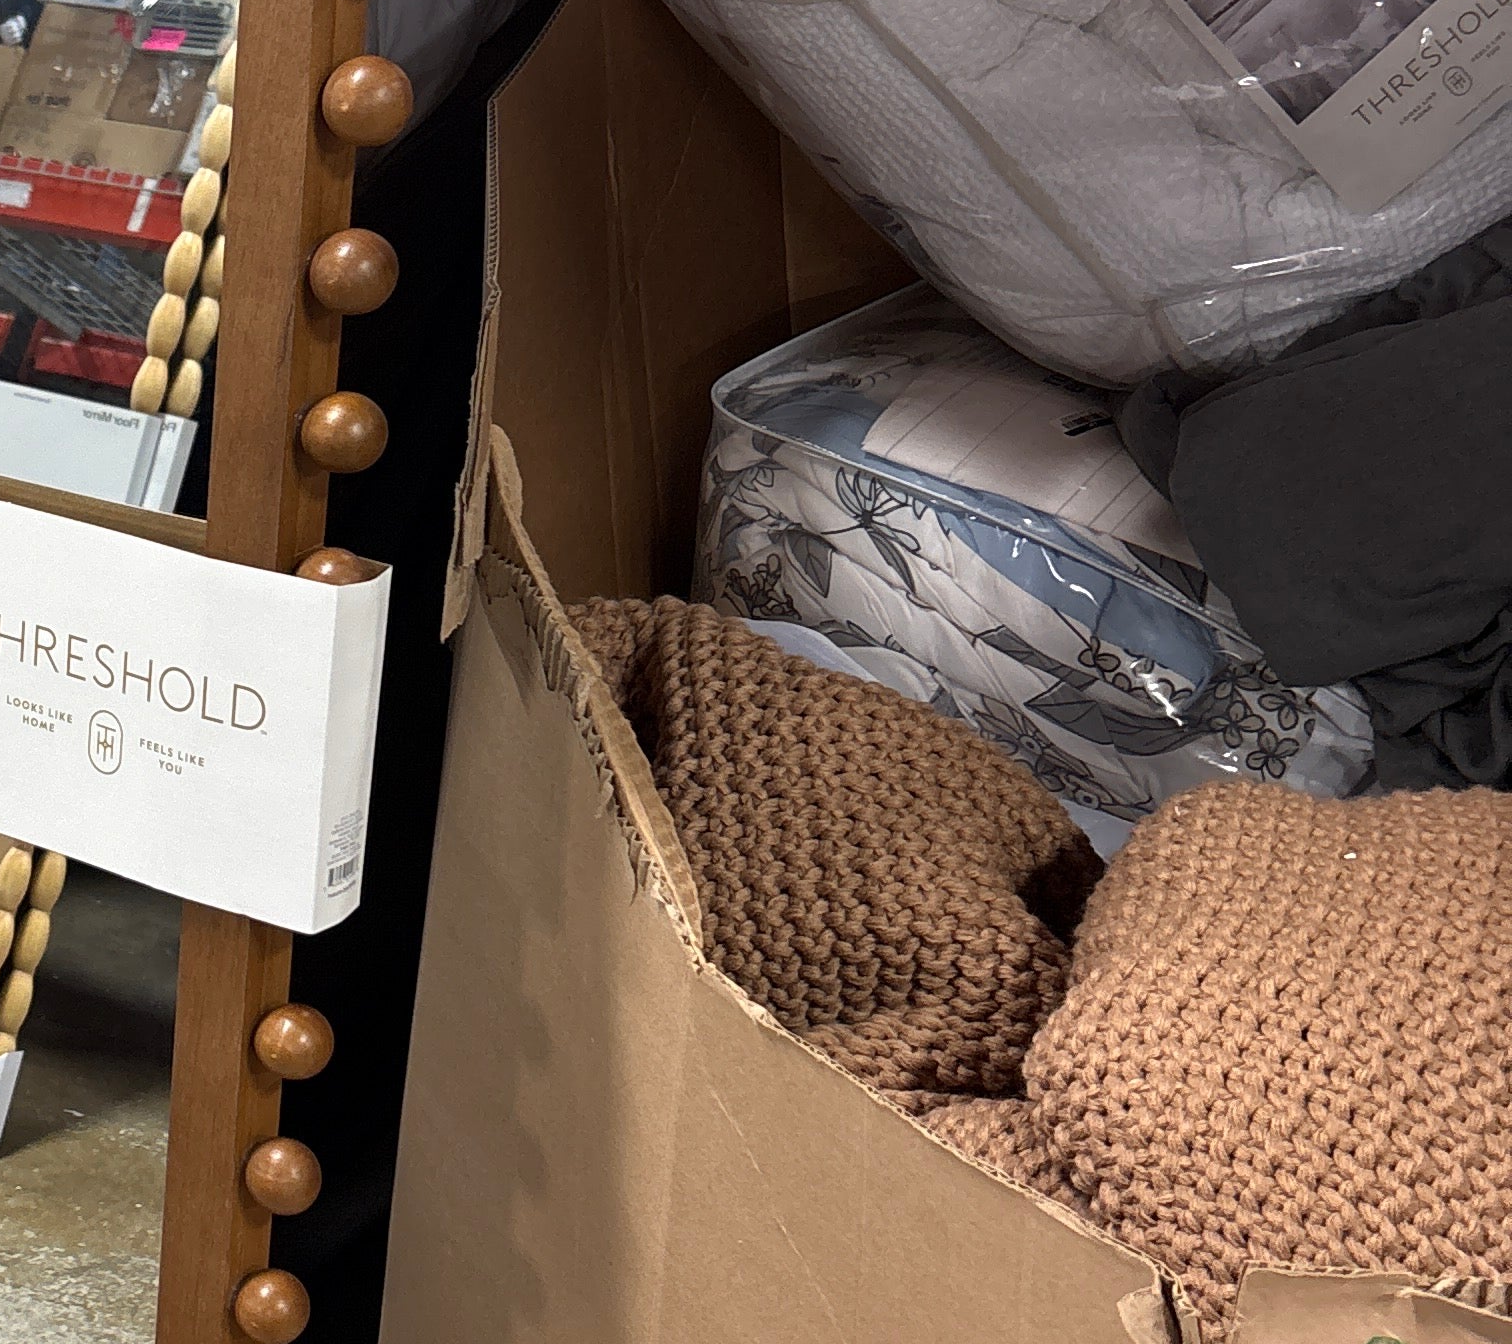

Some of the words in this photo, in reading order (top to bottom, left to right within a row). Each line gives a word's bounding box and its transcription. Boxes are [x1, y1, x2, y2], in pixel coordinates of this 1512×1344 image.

[6, 694, 44, 715] LOOKS
[48, 707, 73, 724] LIKE
[22, 715, 55, 733] HOME
[139, 738, 174, 757] FEELS
[177, 751, 205, 768] LIKE
[158, 759, 182, 775] YOU
